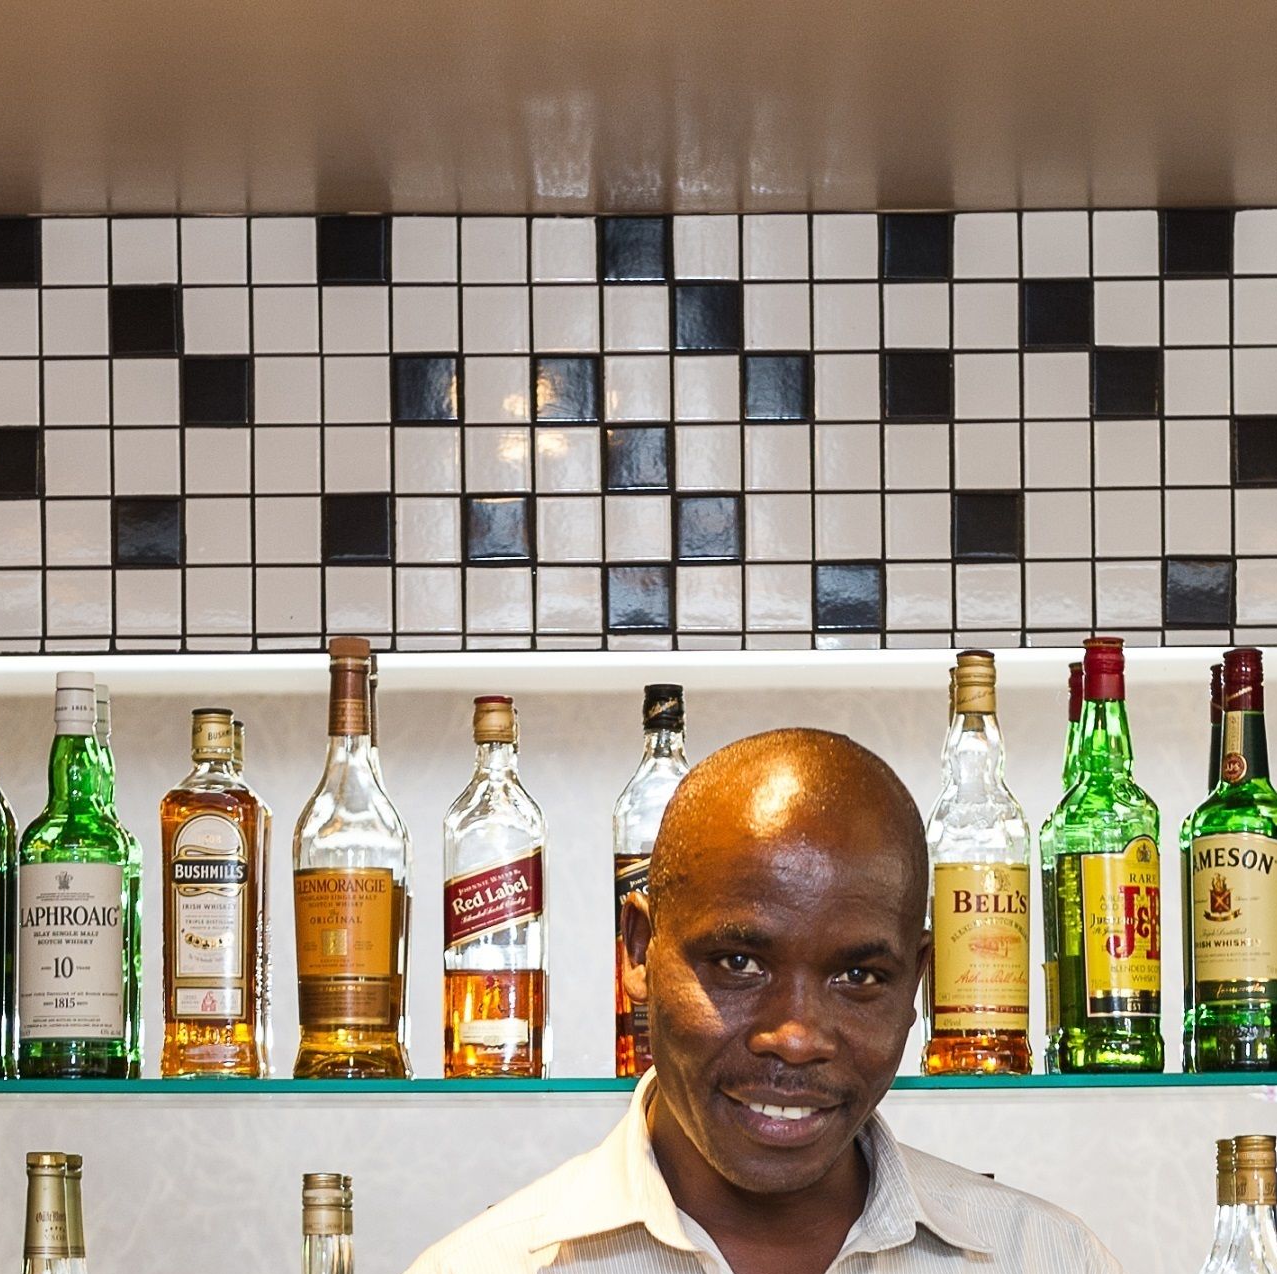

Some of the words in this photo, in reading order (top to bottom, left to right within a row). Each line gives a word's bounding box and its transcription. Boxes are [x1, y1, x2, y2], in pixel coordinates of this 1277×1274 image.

[174, 863, 244, 879] BUSHMILLS
[359, 893, 377, 901] MALT
[452, 891, 485, 915] Red
[485, 875, 529, 903] Label
[182, 903, 202, 911] IRISH
[952, 890, 1027, 914] BELL'S
[21, 905, 119, 928] LAPHROAIG
[309, 915, 363, 925] ORIGINAL
[37, 938, 63, 946] SCOTCH
[65, 938, 94, 946] WHISKY
[53, 957, 74, 979] 10
[1110, 965, 1145, 973] BLENDED
[54, 997, 75, 1009] 1815
